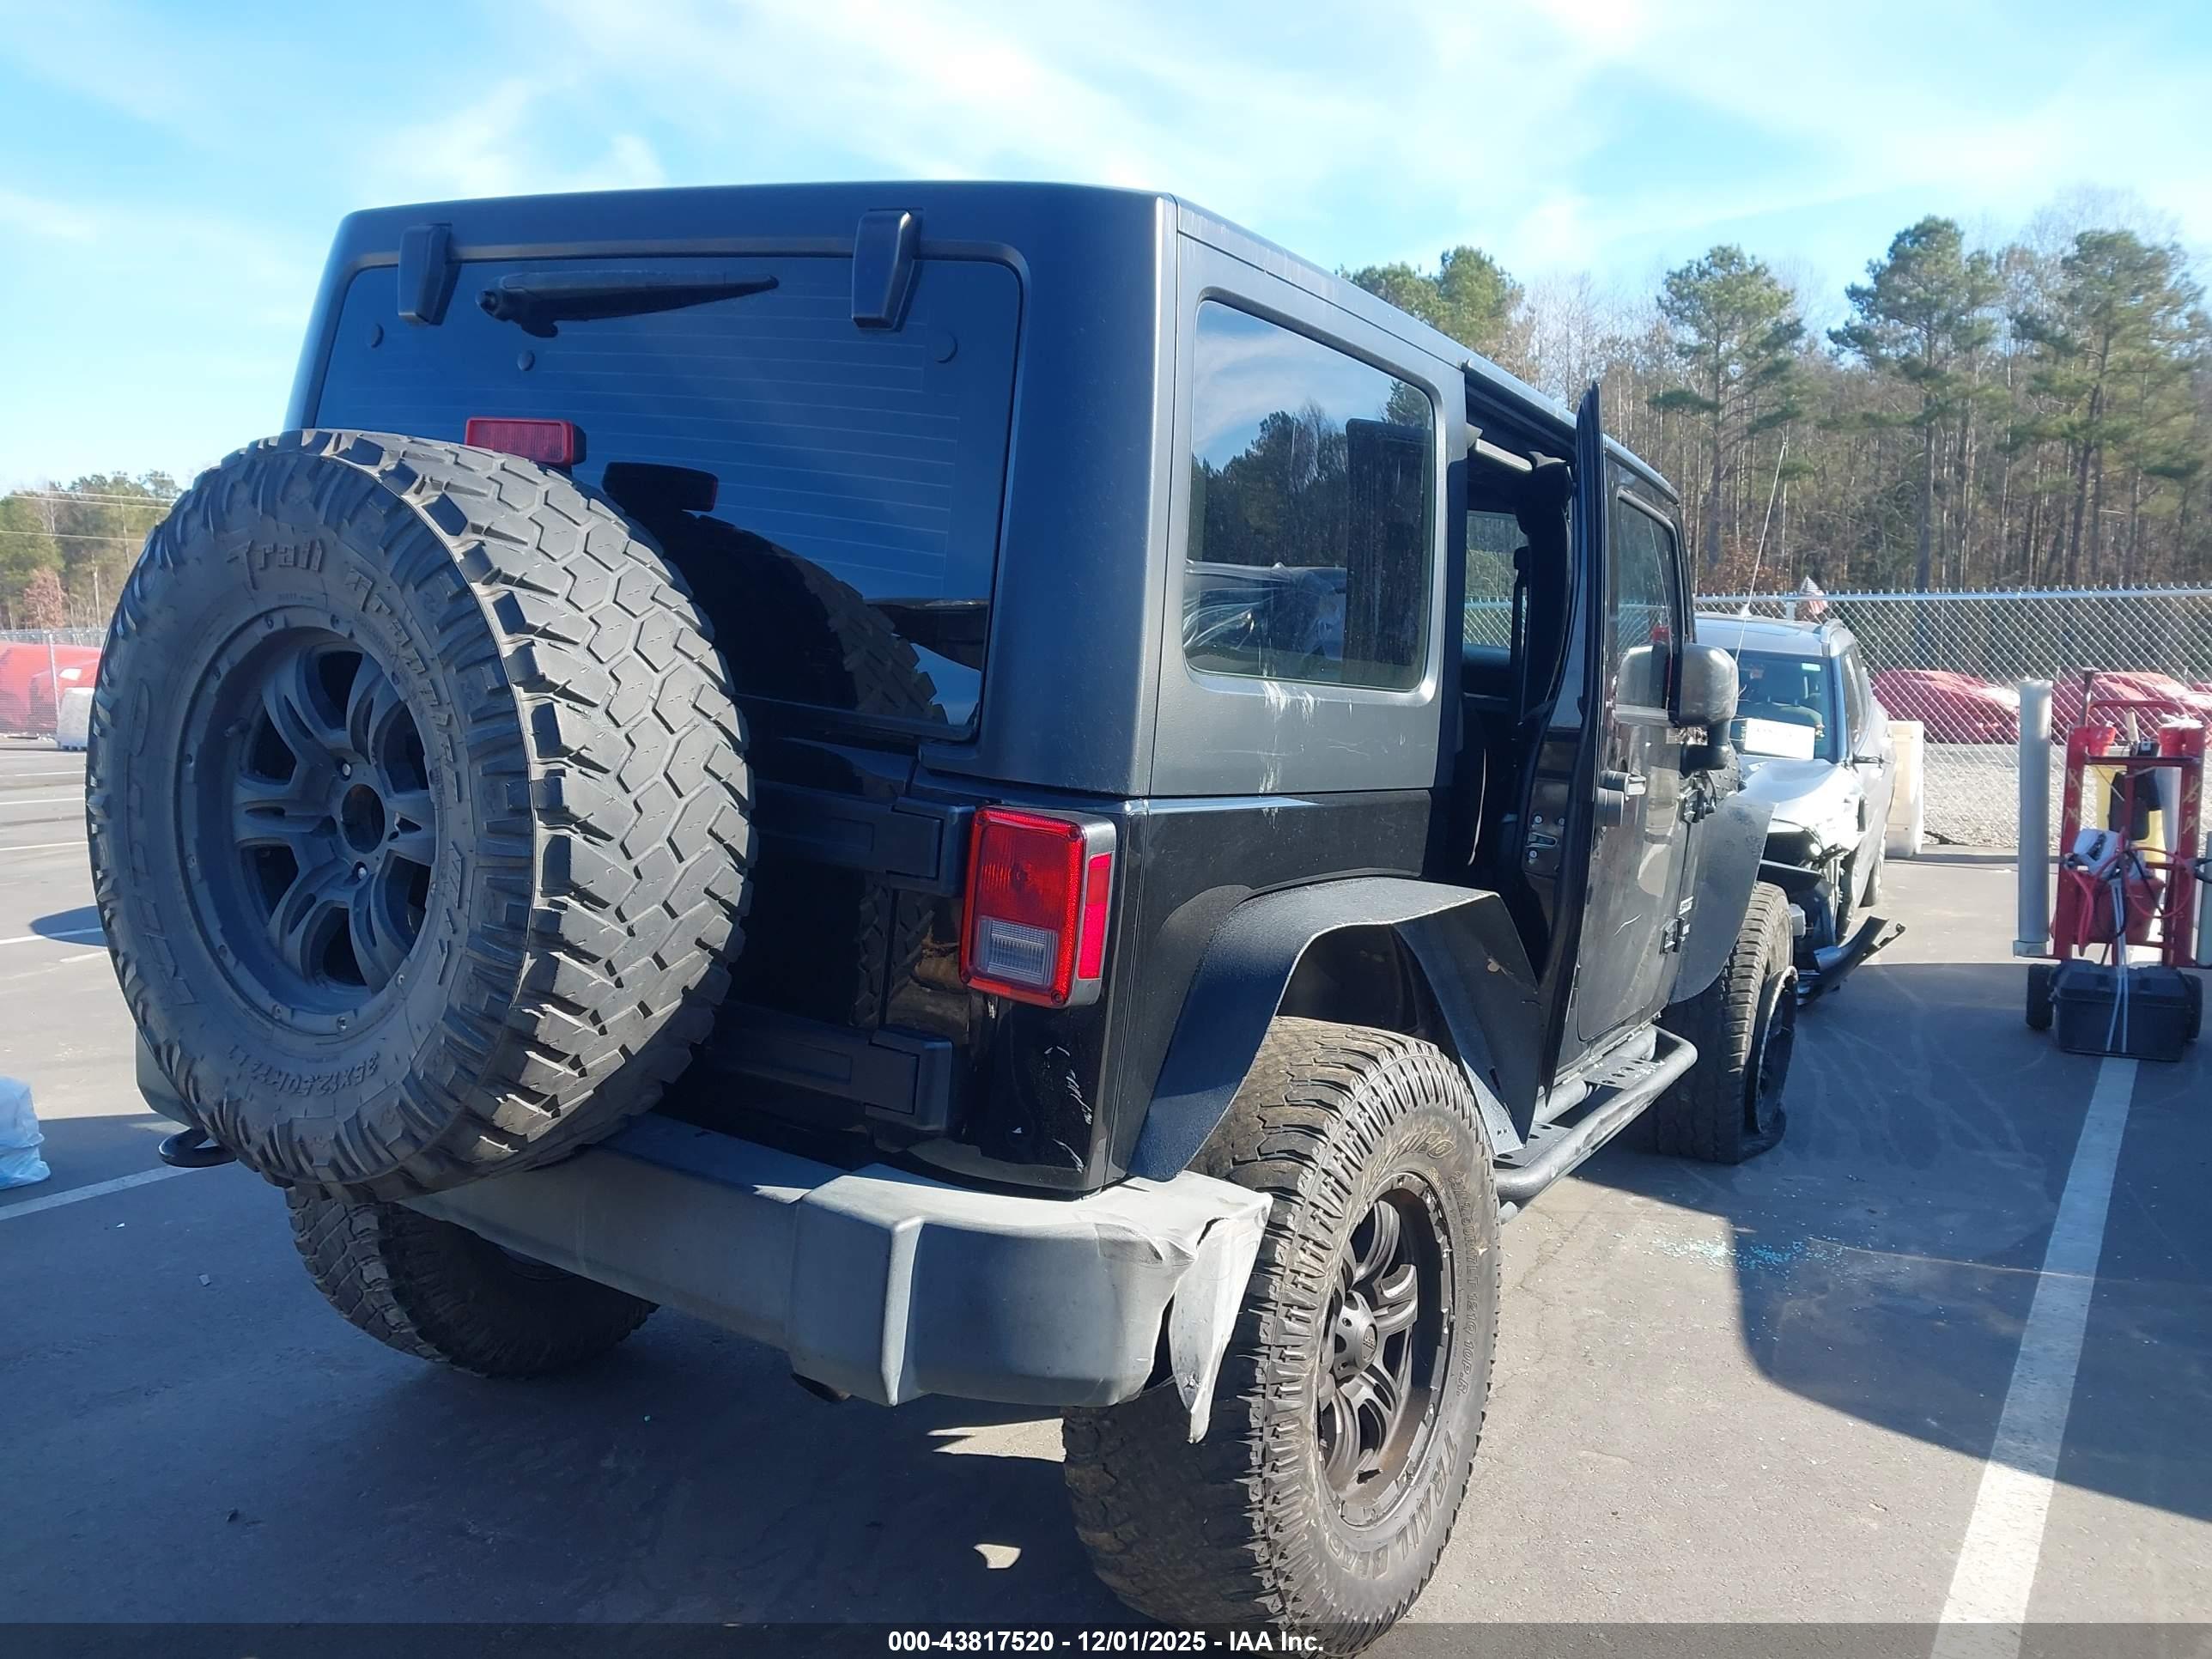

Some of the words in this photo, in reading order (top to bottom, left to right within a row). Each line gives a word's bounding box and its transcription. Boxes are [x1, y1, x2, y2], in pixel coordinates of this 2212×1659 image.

[227, 538, 325, 591] Trail
[1463, 1292, 1478, 1335] 121Q
[1395, 1430, 1458, 1561] TRAIL
